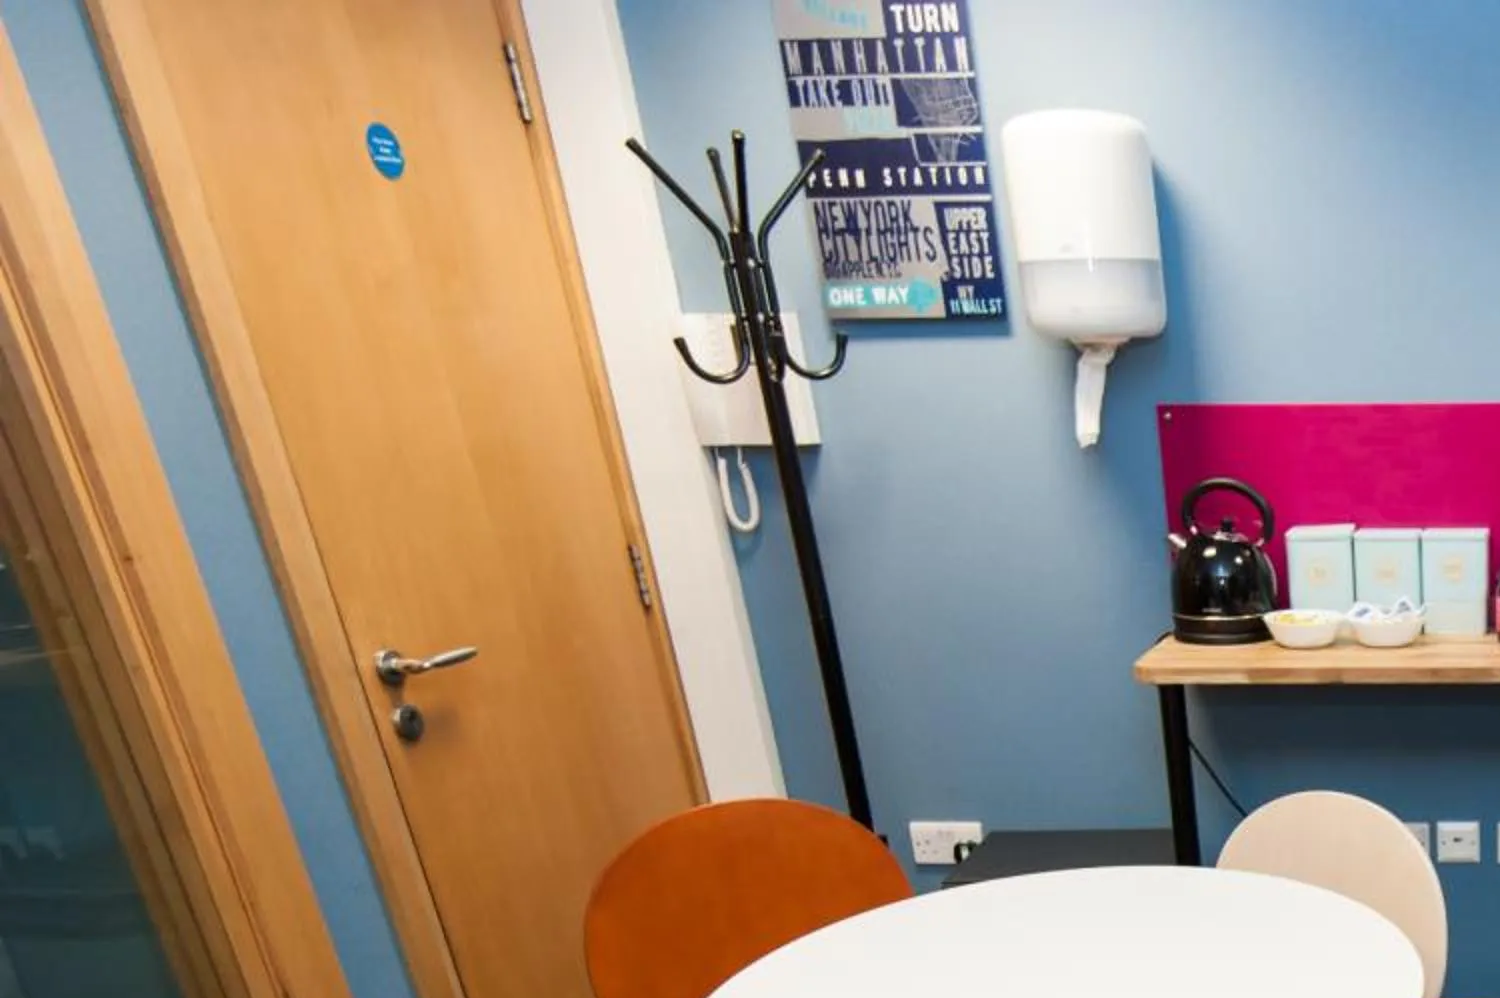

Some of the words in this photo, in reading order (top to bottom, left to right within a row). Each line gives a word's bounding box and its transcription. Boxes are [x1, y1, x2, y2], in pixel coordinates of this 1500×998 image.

[889, 3, 960, 34] TURN
[783, 37, 970, 76] MANHATTAN
[794, 79, 844, 110] TAKE
[807, 168, 866, 188] PENN
[882, 166, 986, 187] STATION
[944, 207, 988, 231] UPPER
[947, 232, 990, 255] EAST
[951, 255, 996, 280] SIDE
[828, 287, 867, 306] ONE
[871, 286, 910, 305] WAY
